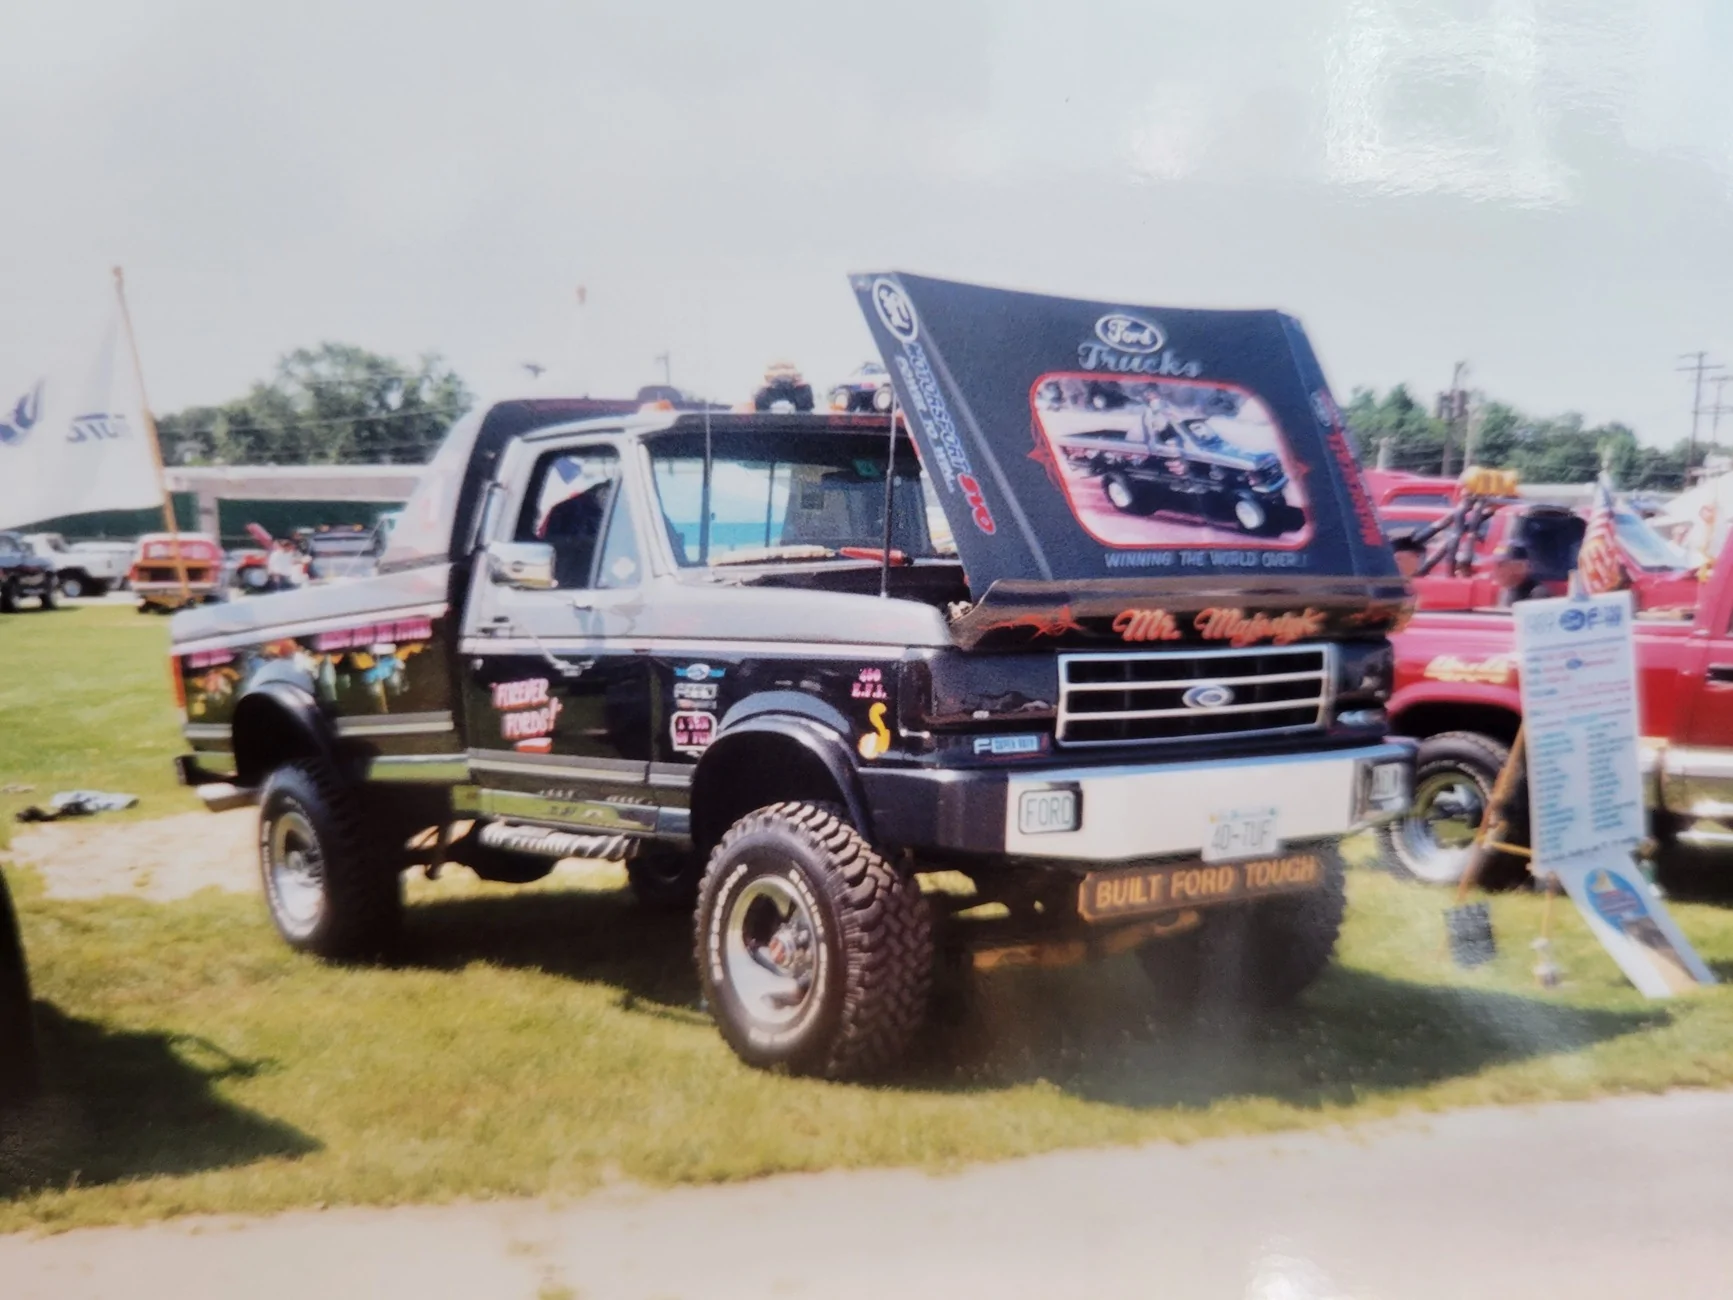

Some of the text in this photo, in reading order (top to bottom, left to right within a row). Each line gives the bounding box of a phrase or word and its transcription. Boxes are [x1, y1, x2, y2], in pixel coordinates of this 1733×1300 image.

[1105, 318, 1156, 346] Ford
[1078, 341, 1201, 377] Trucks
[1104, 551, 1172, 568] WINNING
[1179, 551, 1205, 567] THE
[1210, 551, 1257, 568] WORLD
[1112, 609, 1183, 641] Mr.
[1026, 796, 1073, 827] FORD
[1096, 855, 1316, 909] BUILT FORD TOUGH
